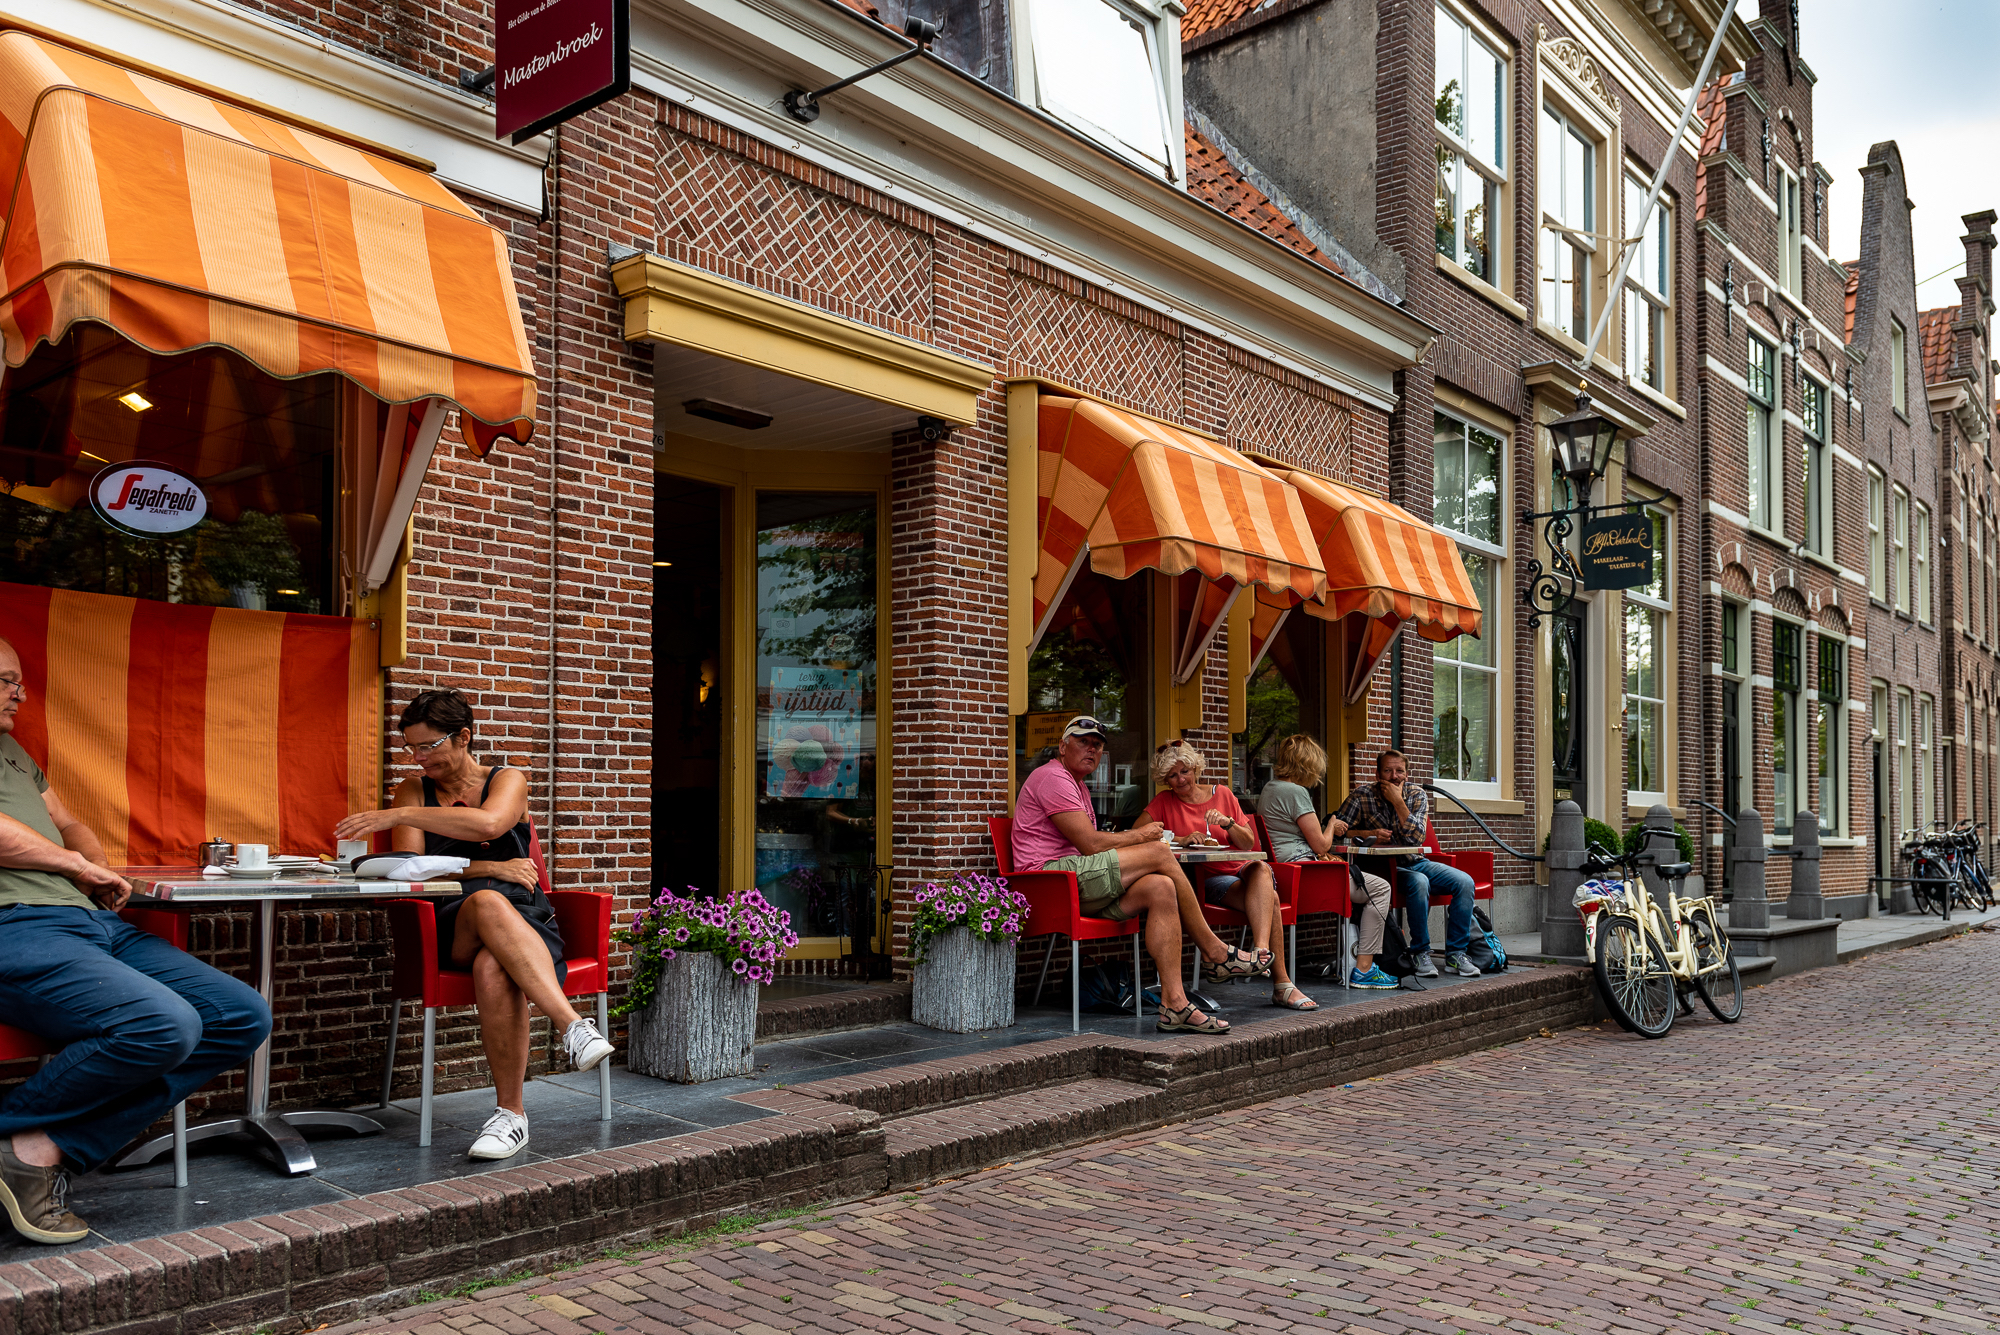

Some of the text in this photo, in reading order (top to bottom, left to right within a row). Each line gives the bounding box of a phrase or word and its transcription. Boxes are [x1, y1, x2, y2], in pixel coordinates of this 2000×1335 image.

[507, 20, 517, 30] Het
[517, 11, 530, 24] Gilde
[531, 7, 540, 17] van
[540, 2, 546, 12] de
[503, 21, 604, 90] Mastenbroek
[107, 473, 198, 512] Segafredo
[149, 507, 179, 516] ZANETTI
[794, 681, 835, 692] naar de
[798, 672, 827, 684] terug
[784, 691, 847, 719] ijstijd
